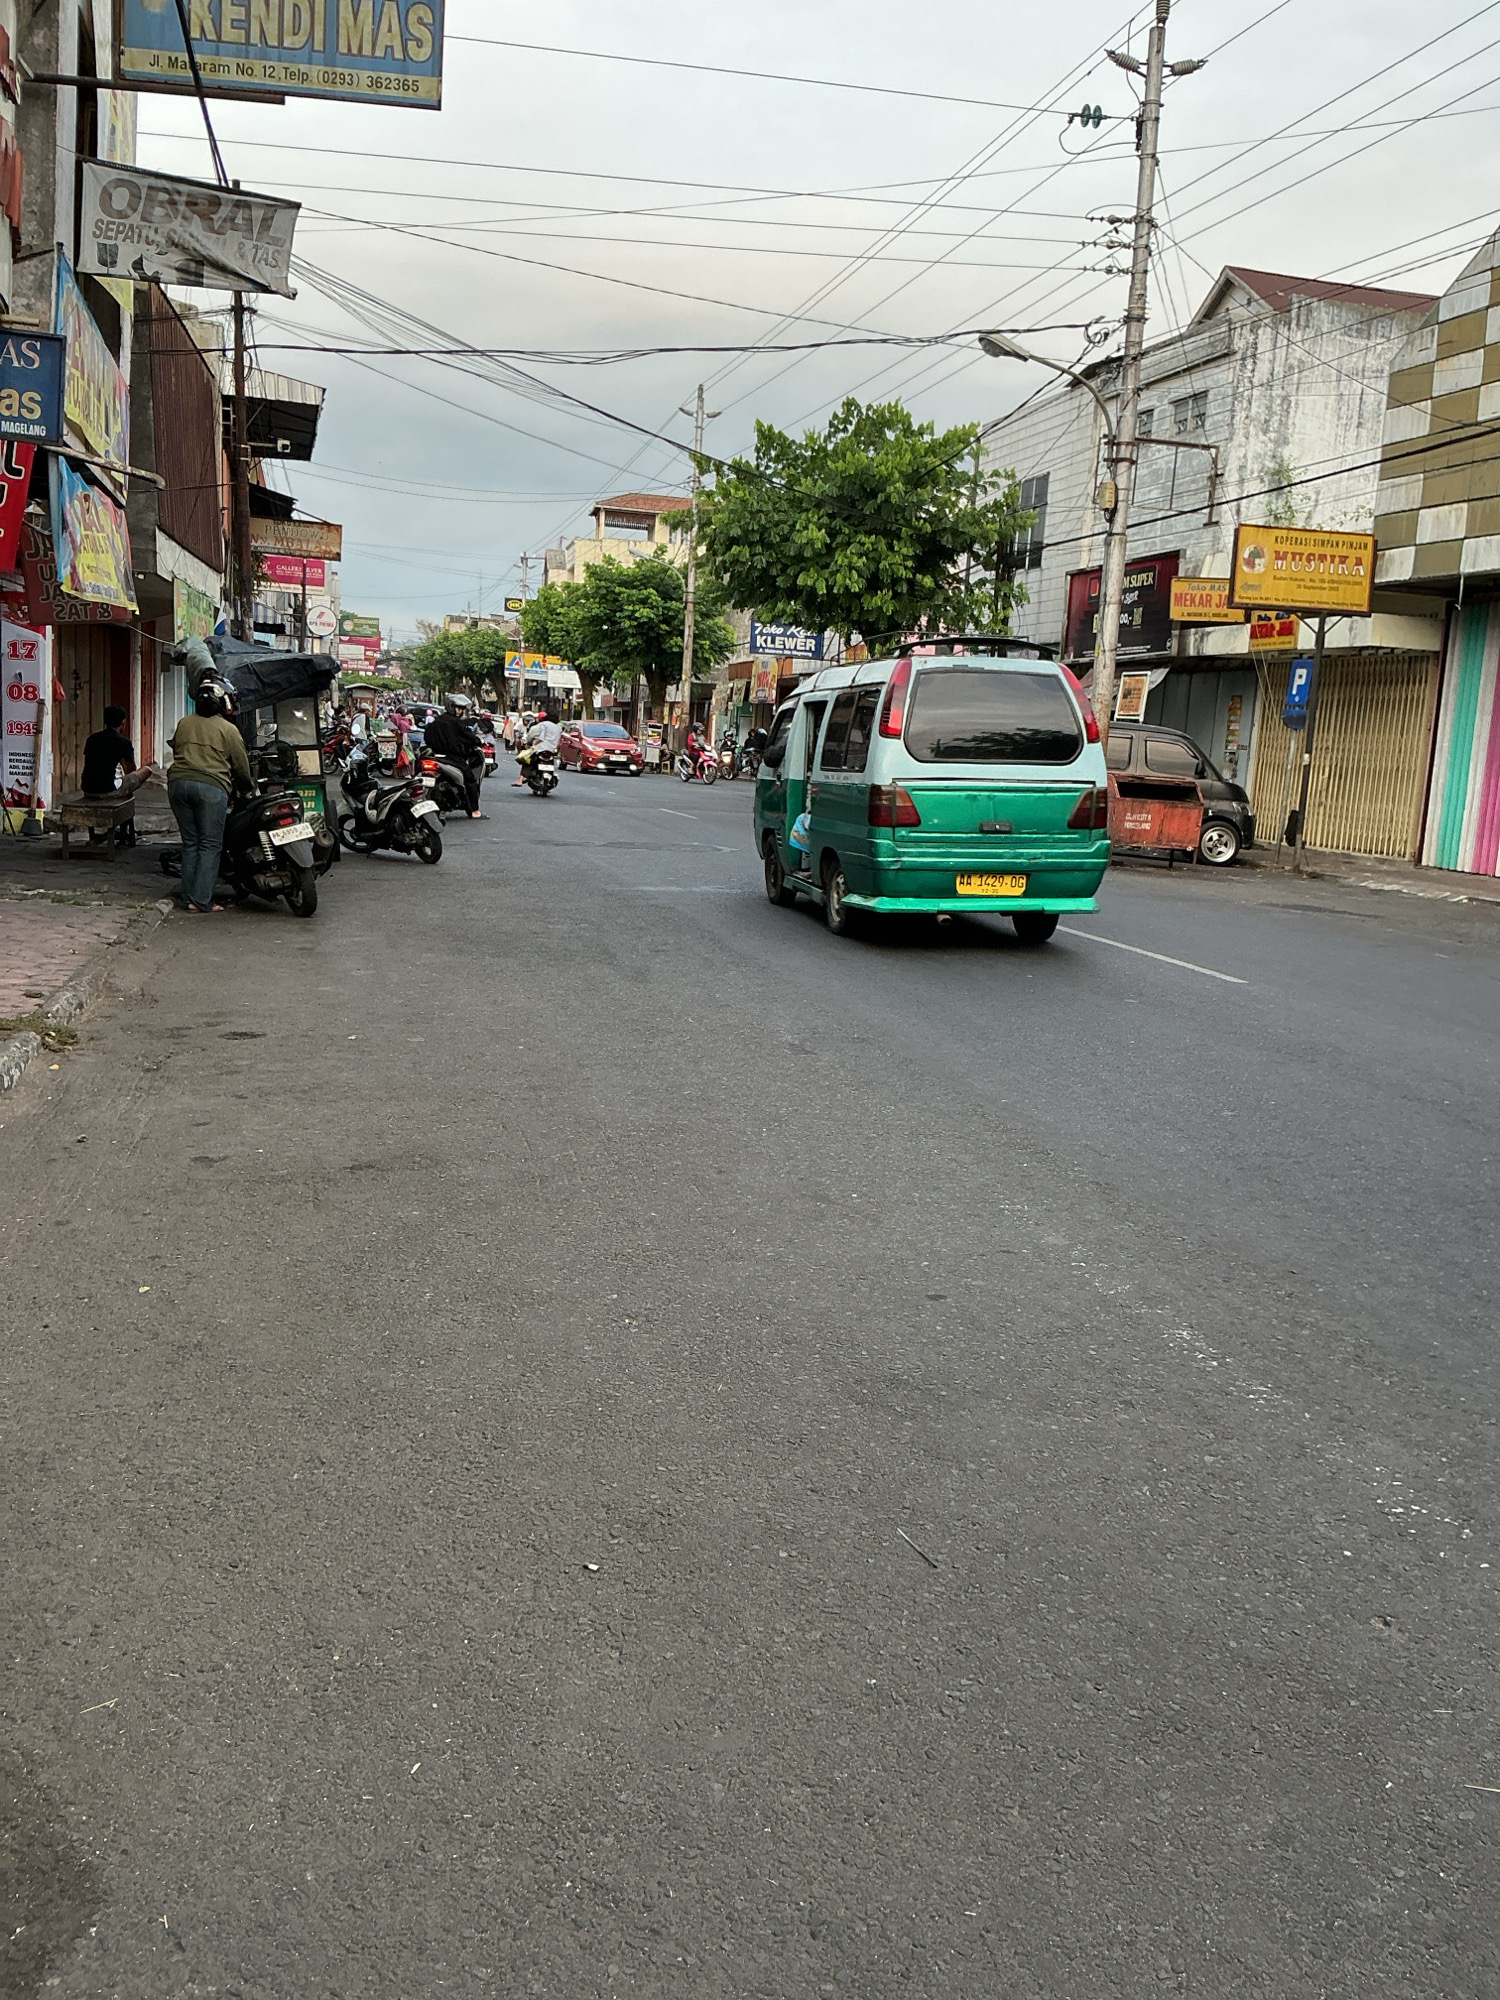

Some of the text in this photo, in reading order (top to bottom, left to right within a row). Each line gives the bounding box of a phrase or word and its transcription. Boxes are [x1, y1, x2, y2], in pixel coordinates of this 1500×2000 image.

[190, 0, 434, 63] KENDI MAS
[149, 54, 164, 68] Jl.
[168, 58, 230, 75] Maaram
[236, 62, 258, 78] No.
[316, 69, 360, 88] (0293)
[366, 75, 420, 93] 362365
[99, 178, 286, 247] OBRAL
[251, 243, 281, 268] TAS
[1, 421, 47, 437] MAGELANG
[1274, 536, 1368, 551] KOPERASI SIMPAN PINJAM
[1272, 550, 1365, 576] MUSTIKA
[1130, 572, 1154, 588] SUPER
[1188, 583, 1227, 592] Toko MAS
[1174, 592, 1229, 608] MEKAR JA
[754, 622, 784, 635] Toko
[7, 640, 38, 661] 17
[756, 634, 816, 652] KLEWER
[1292, 668, 1308, 694] P
[7, 682, 39, 702] 08
[7, 720, 38, 736] 1945
[958, 873, 972, 886] AA
[977, 874, 1004, 888] 1429
